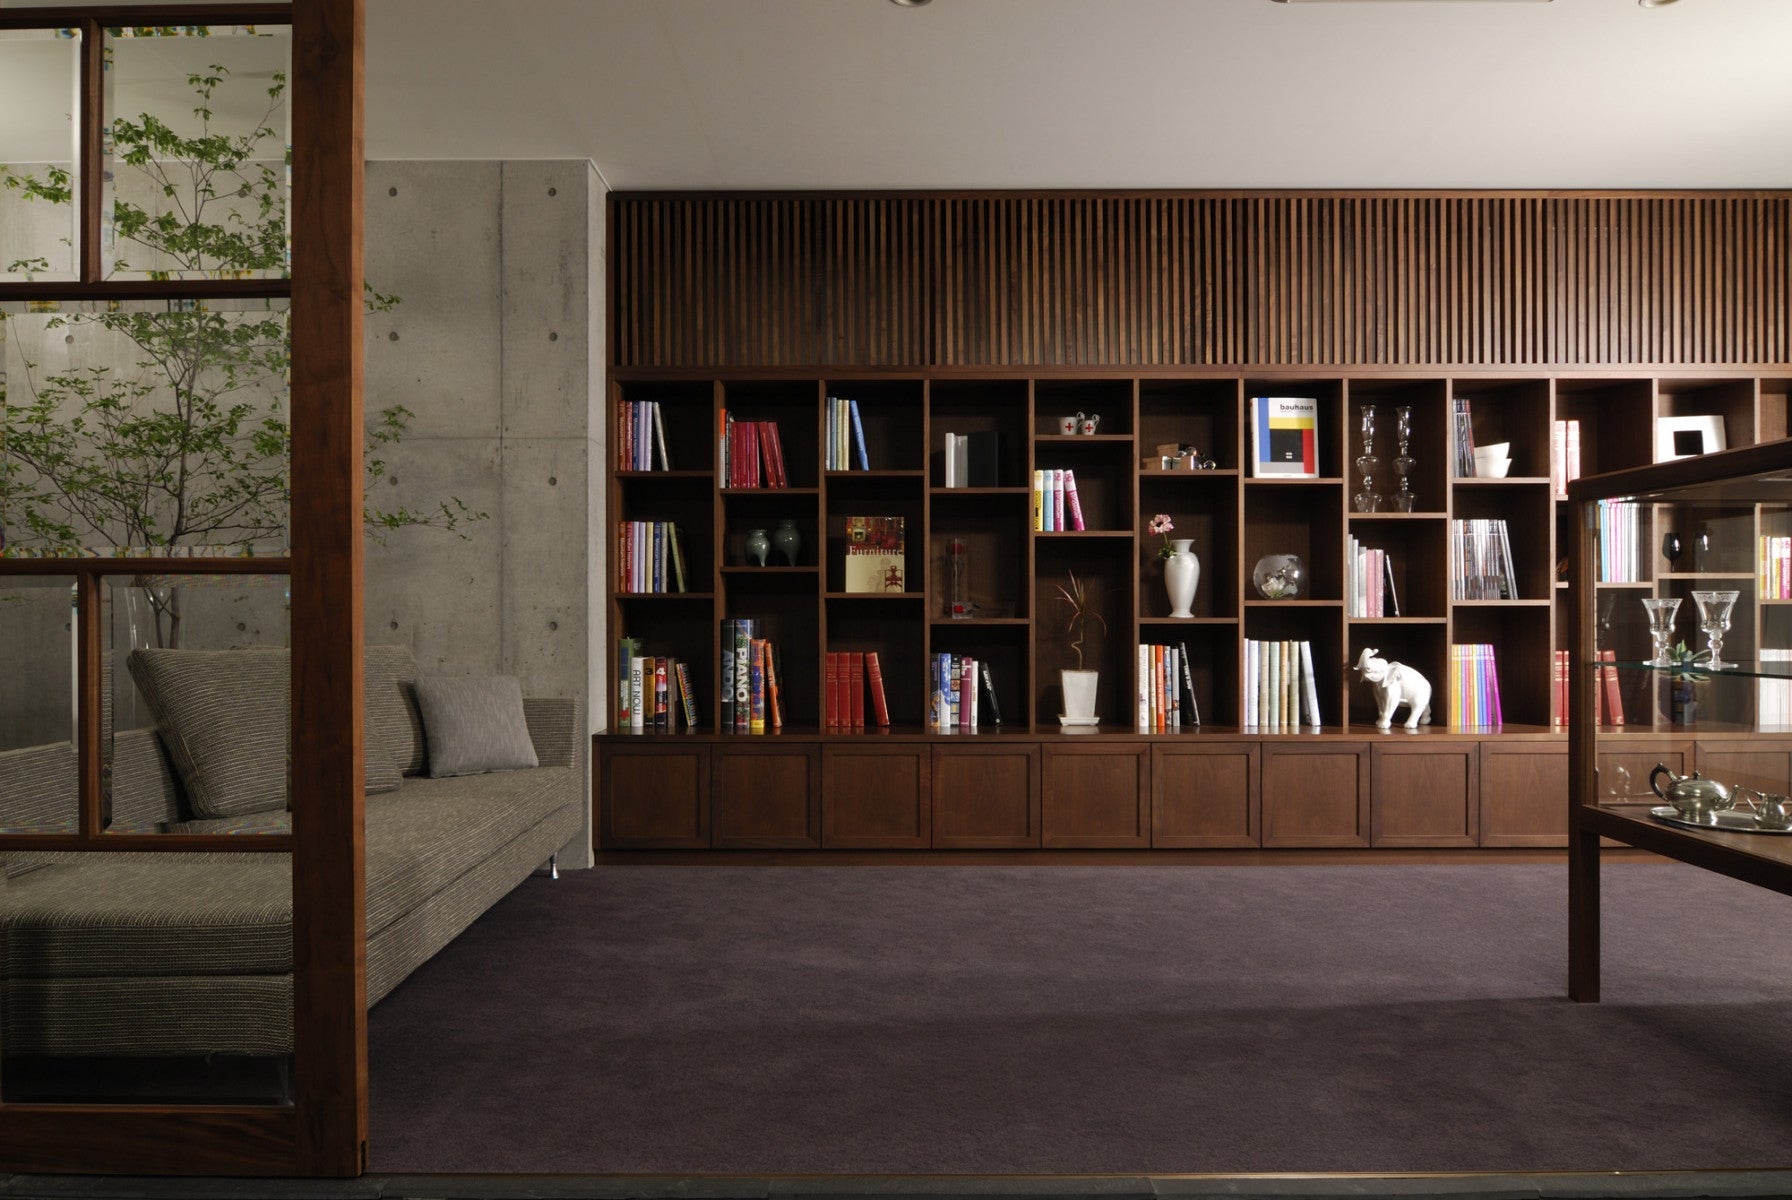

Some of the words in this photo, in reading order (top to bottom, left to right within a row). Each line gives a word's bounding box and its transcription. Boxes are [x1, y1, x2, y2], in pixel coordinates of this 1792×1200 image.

[849, 545, 903, 556] Furniture
[633, 669, 641, 687] ART
[645, 667, 653, 675] 3
[656, 667, 665, 676] 4
[722, 649, 734, 700] ANDO
[736, 647, 748, 702] PIANO
[633, 690, 641, 715] NOW
